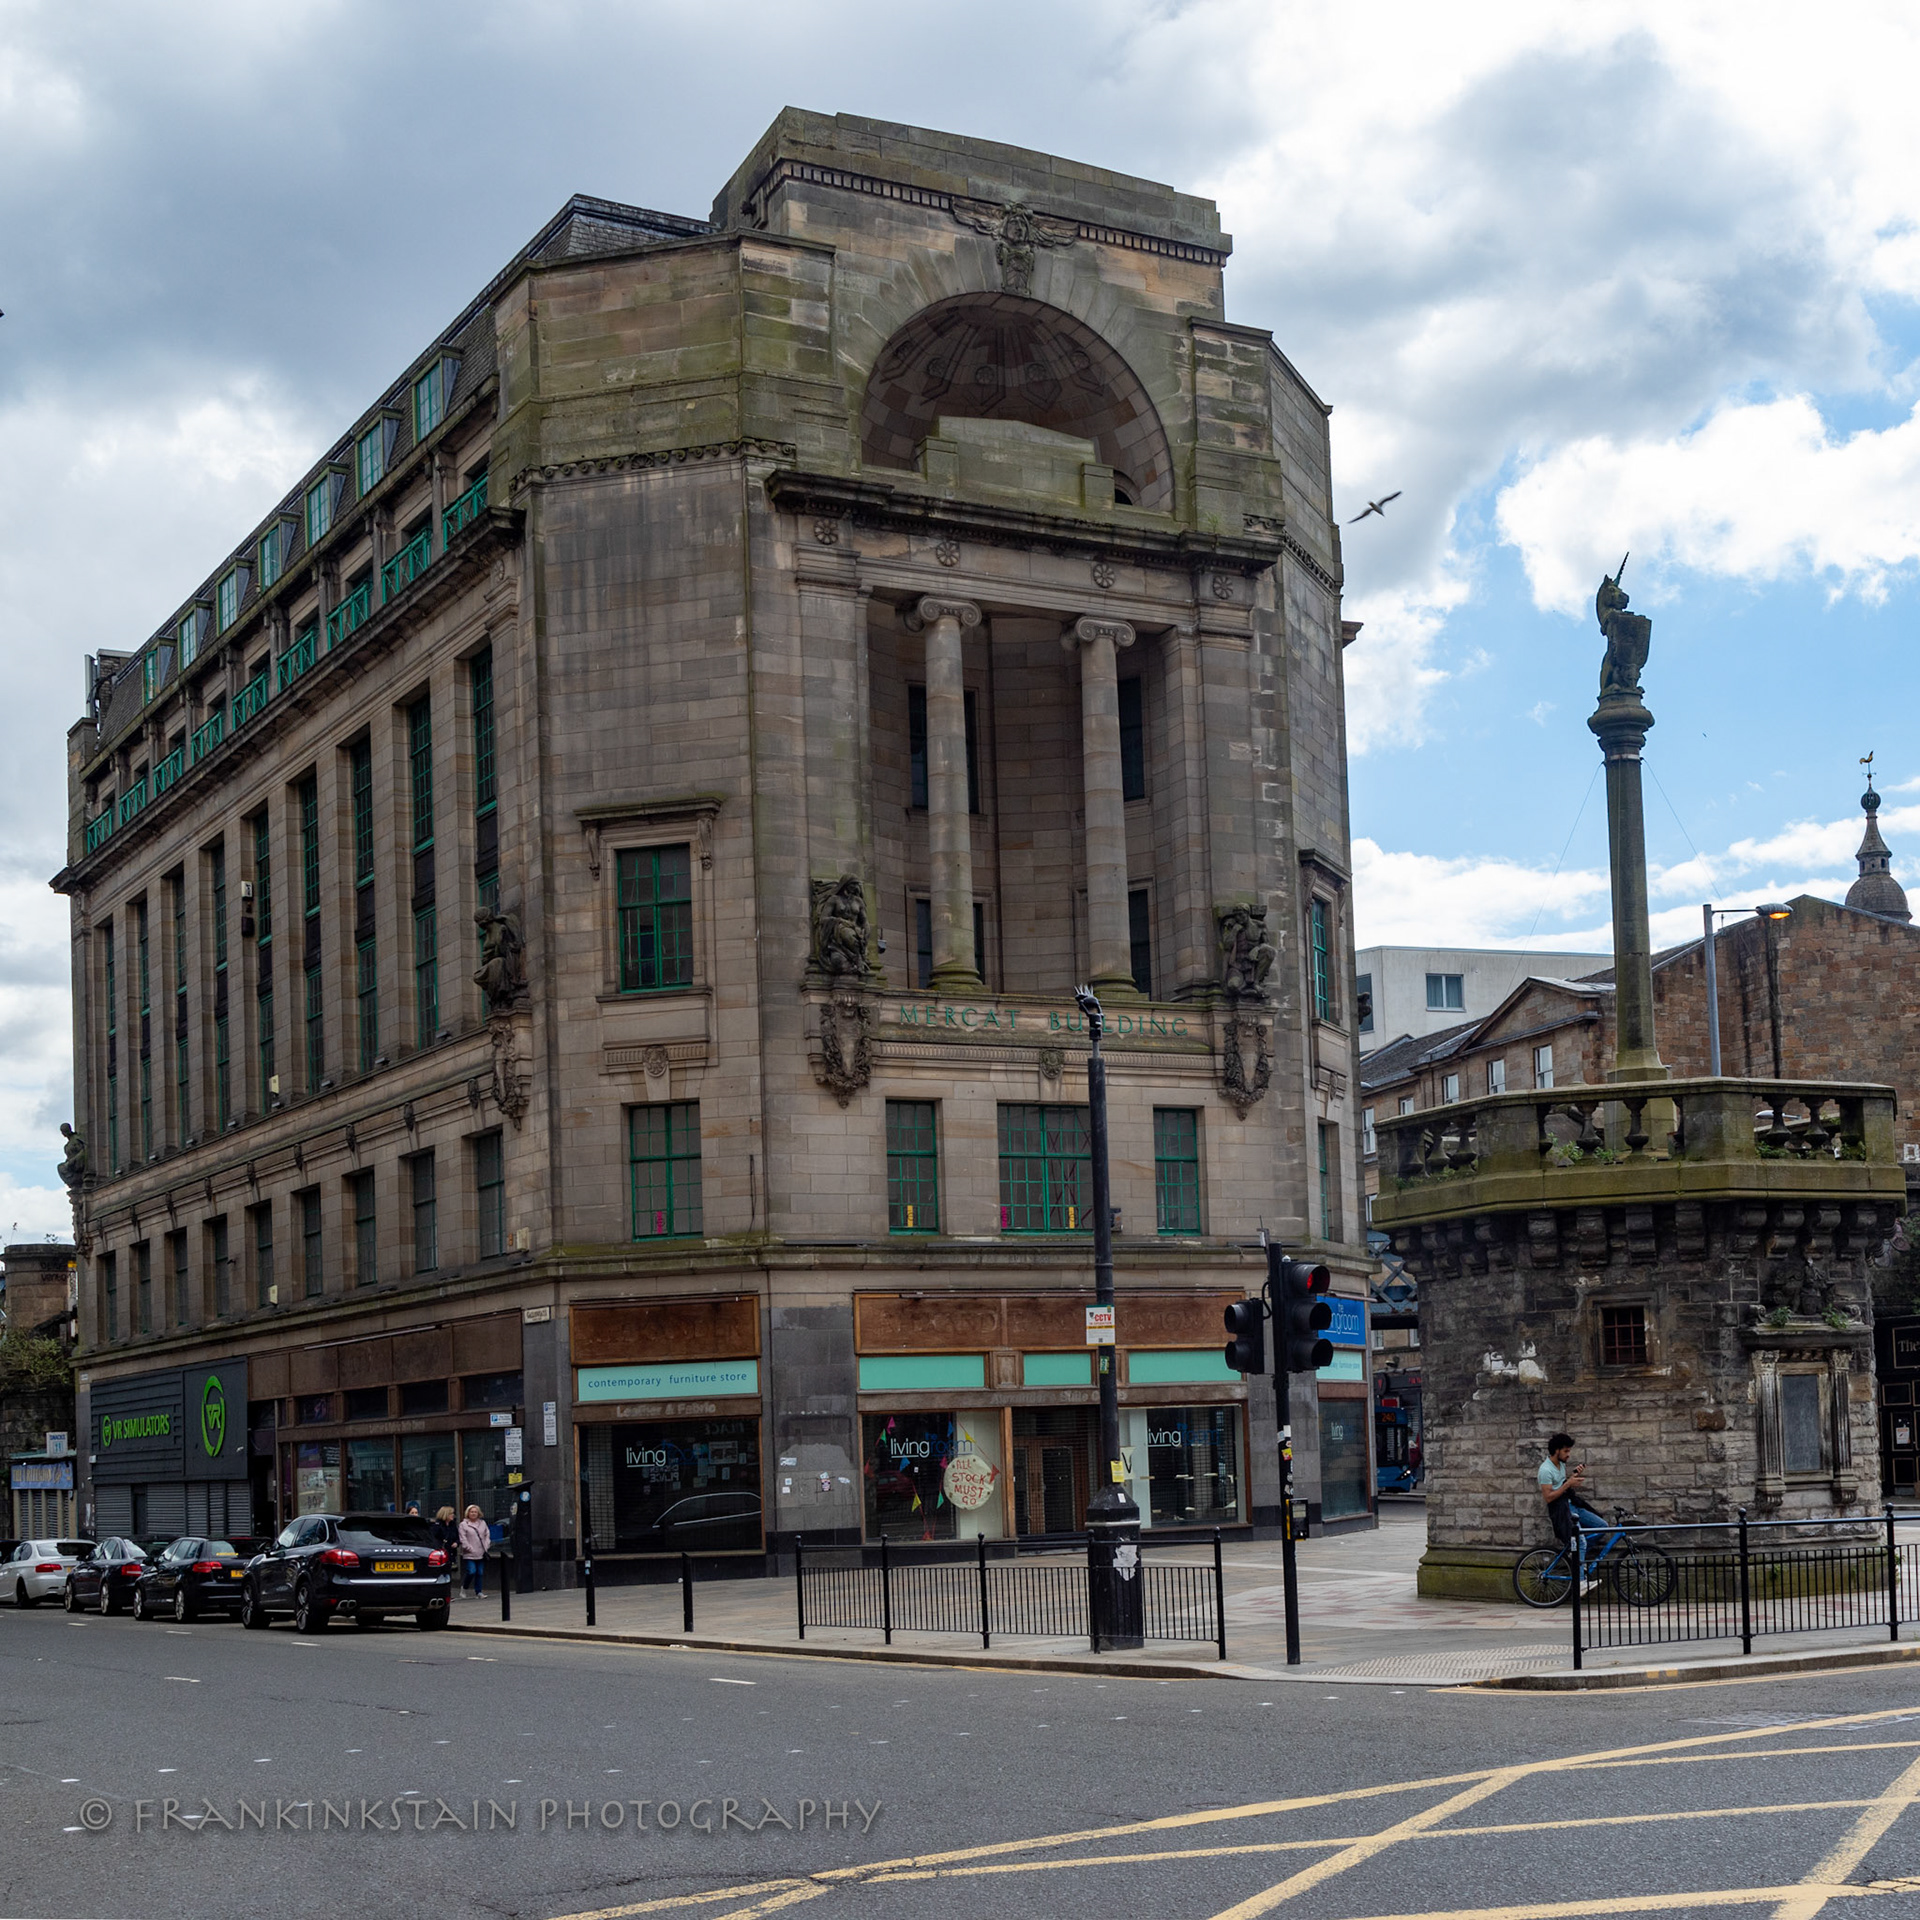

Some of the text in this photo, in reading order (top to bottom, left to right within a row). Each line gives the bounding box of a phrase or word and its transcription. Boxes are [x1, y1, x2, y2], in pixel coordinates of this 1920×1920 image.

[900, 1005, 1188, 1036] MERCAT BULDING
[1094, 1313, 1112, 1322] CCTV
[588, 1372, 747, 1389] contemporary furniture store
[112, 1413, 170, 1440] VR SIMULATORS
[626, 1446, 667, 1467] living
[955, 1458, 973, 1470] ALL
[951, 1472, 987, 1486] STOCK
[953, 1484, 984, 1499] MUST
[961, 1495, 977, 1506] GO
[379, 1562, 395, 1570] LR13
